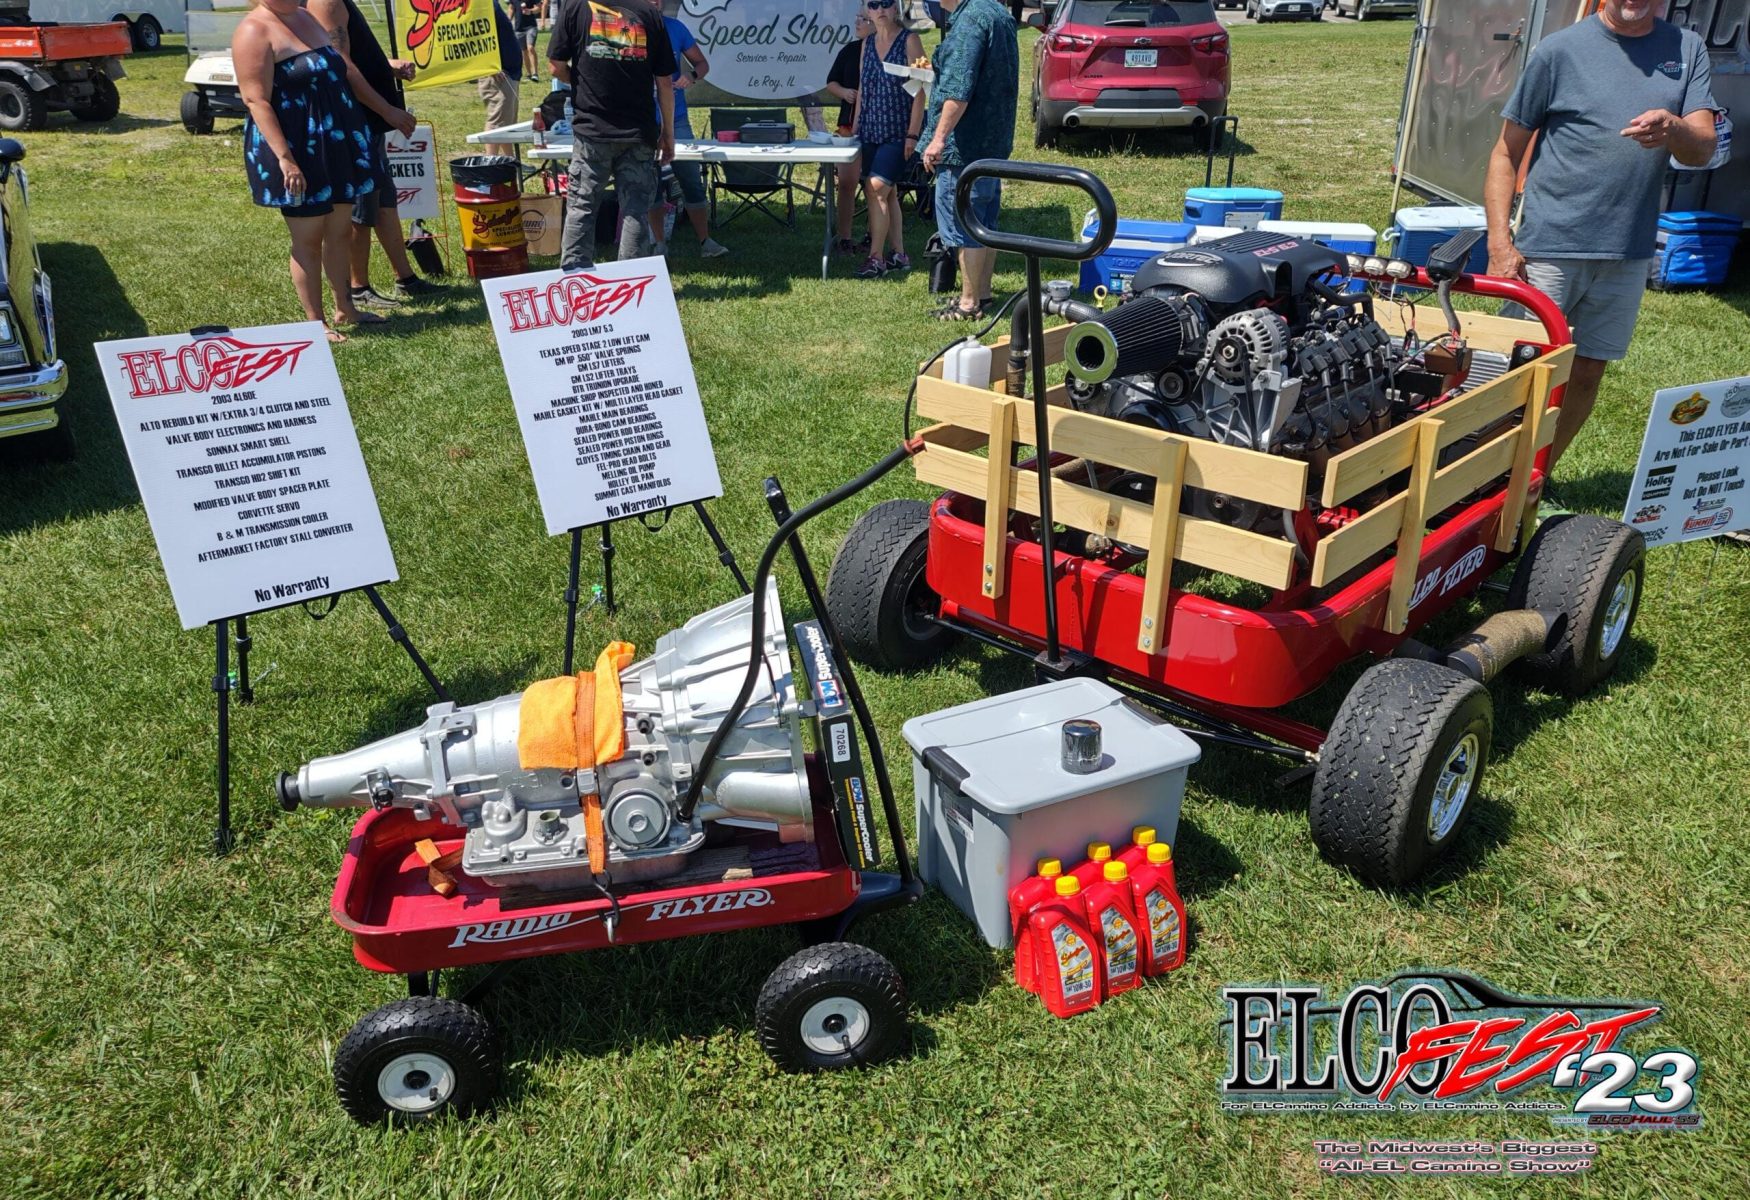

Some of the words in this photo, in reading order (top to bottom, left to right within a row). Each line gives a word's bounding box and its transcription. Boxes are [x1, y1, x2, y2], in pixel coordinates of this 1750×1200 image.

[437, 18, 491, 42] SPECIALIZED
[695, 13, 776, 55] Speed
[783, 12, 853, 54] Shop
[443, 36, 496, 61] LUBRICANTS
[736, 52, 768, 63] Service
[777, 52, 808, 64] Repair
[748, 76, 760, 87] Le
[786, 76, 796, 87] IL
[571, 328, 588, 338] 2003
[539, 347, 561, 359] TEXAS
[561, 344, 581, 355] SPEED
[581, 341, 601, 351] STAGE
[602, 340, 607, 348] 2
[607, 338, 622, 347] LOW
[622, 335, 635, 345] LIFT
[635, 333, 650, 343] CAM
[571, 375, 582, 384] GM
[595, 369, 615, 380] LIFTER
[616, 366, 637, 376] TRAYS
[577, 363, 588, 372] GM
[601, 357, 625, 368] LIFTERS
[211, 394, 232, 405] 2003
[140, 420, 161, 432] ALTO
[162, 416, 195, 429] REBUILD
[195, 414, 209, 424] KIT
[210, 408, 249, 422] W/EXTRA
[249, 406, 265, 416] 3/4
[265, 402, 293, 414] CLUTCH
[294, 400, 310, 410] AND
[310, 397, 331, 408] STEEL
[578, 412, 601, 423] MAHLE
[601, 409, 619, 419] MAIN
[619, 403, 649, 416] BEARINGS
[165, 433, 192, 445] VALVE
[193, 430, 214, 441] BODY
[216, 422, 266, 438] ELECTRONICS
[267, 420, 283, 430] AND
[283, 415, 317, 428] HARNESS
[1680, 430, 1696, 443] This
[1696, 426, 1715, 440] ELCO
[1716, 422, 1740, 437] FLYER
[206, 444, 240, 457] SONNAX
[240, 439, 268, 451] SMART
[268, 436, 290, 447] SHELL
[577, 443, 601, 456] SEALED
[601, 439, 624, 450] POWER
[624, 435, 646, 446] PISTON
[646, 430, 664, 441] RINGS
[600, 449, 622, 460] TIMING
[622, 446, 641, 456] CHAIN
[642, 442, 655, 452] AND
[655, 439, 671, 450] GEAR
[1654, 450, 1670, 462] Are
[1671, 446, 1686, 459] Not
[1686, 444, 1702, 456] For
[1702, 442, 1718, 454] Sale
[1720, 440, 1730, 451] Or
[1730, 436, 1748, 449] Part
[176, 465, 214, 479] TRANSGO
[214, 460, 239, 473] BILLET
[241, 452, 296, 468] ACCUMULATOR
[296, 446, 326, 459] PISTONS
[596, 459, 621, 472] FEL-PRO
[621, 456, 638, 466] HEAD
[638, 452, 657, 463] BOLTS
[601, 468, 628, 480] MELLING
[628, 466, 638, 475] OIL
[638, 462, 656, 472] PUMP
[214, 475, 251, 489] TRANSGO
[267, 469, 288, 480] SHIFT
[288, 467, 301, 476] KIT
[607, 477, 629, 489] HOLLEY
[630, 475, 640, 484] OIL
[641, 472, 654, 481] PAN
[1644, 476, 1674, 488] Holley
[1696, 470, 1722, 484] Please
[1722, 466, 1740, 478] Look
[193, 497, 230, 511] MODIFIED
[231, 492, 256, 504] VALVE
[257, 489, 276, 500] BODY
[278, 483, 308, 496] SPACER
[308, 479, 330, 490] PLATE
[594, 488, 620, 501] SUMMIT
[620, 485, 637, 495] CAST
[637, 478, 671, 492] MANIFOLDS
[1683, 488, 1696, 500] But
[1698, 486, 1708, 498] Do
[1708, 482, 1723, 495] NOT
[1724, 478, 1746, 492] Touch
[238, 506, 275, 520] CORVETTE
[276, 501, 300, 513] SERVO
[606, 505, 620, 518] No
[620, 495, 667, 514] Warranty
[217, 532, 224, 541] B
[226, 531, 234, 540] &
[235, 528, 244, 538] M
[245, 517, 301, 536] TRANSMISSION
[301, 512, 328, 524] COOLER
[198, 543, 253, 563] AFTERMARKET
[254, 536, 288, 550] FACTORY
[290, 531, 312, 543] STALL
[313, 523, 354, 538] CONVERTER
[1408, 566, 1442, 603] LCO
[1439, 545, 1486, 596] FLYER
[254, 589, 272, 603] No
[272, 576, 330, 598] Warranty
[836, 728, 846, 756] 70268
[448, 912, 572, 948] RADIO
